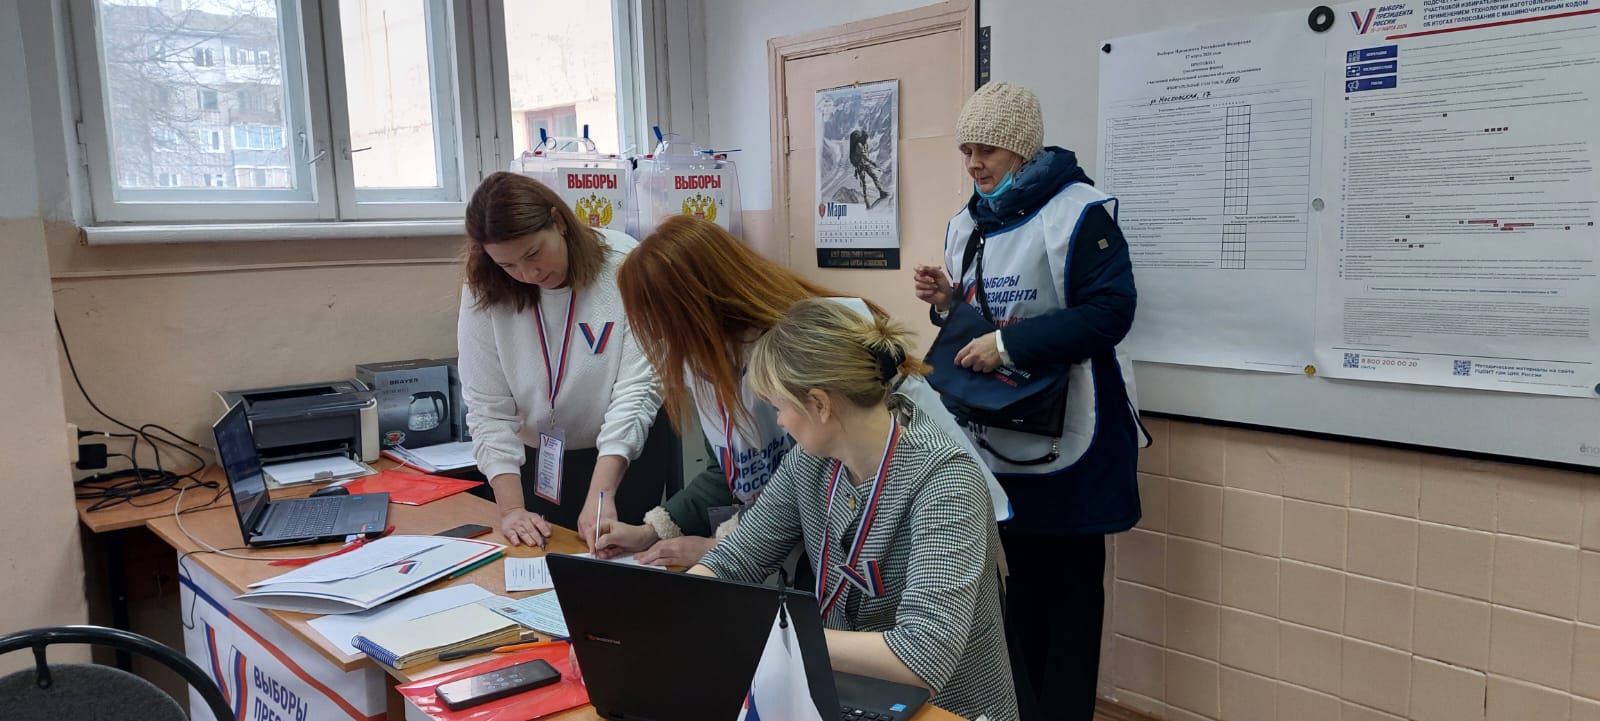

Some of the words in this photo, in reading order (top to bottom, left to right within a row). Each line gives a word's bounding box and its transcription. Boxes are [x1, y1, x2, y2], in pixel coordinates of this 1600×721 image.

[1376, 9, 1413, 20] ПРЕЗИДЕНТА
[1379, 3, 1406, 12] ВЫБОРЫ
[1424, 3, 1460, 13] УЧАСТКОВОЙ
[1428, 9, 1470, 19] ПРИМЕНЕНИЕМ
[1472, 4, 1508, 14] ТЕХНОЛОГИИ
[1454, 13, 1495, 23] ГОЛОСОВАНИЯ
[1502, 3, 1564, 16] МАШИНОЧИТАЕМЫМ
[1565, 0, 1589, 8] КОДОМ
[1373, 19, 1397, 27] РОССИИ
[567, 173, 617, 189] ВЫБОРЫ
[674, 174, 721, 190] ВЫБОРЫ
[986, 289, 1037, 303] ЕЗИДЕНТА
[253, 665, 308, 721] ВЫБОРЫ
